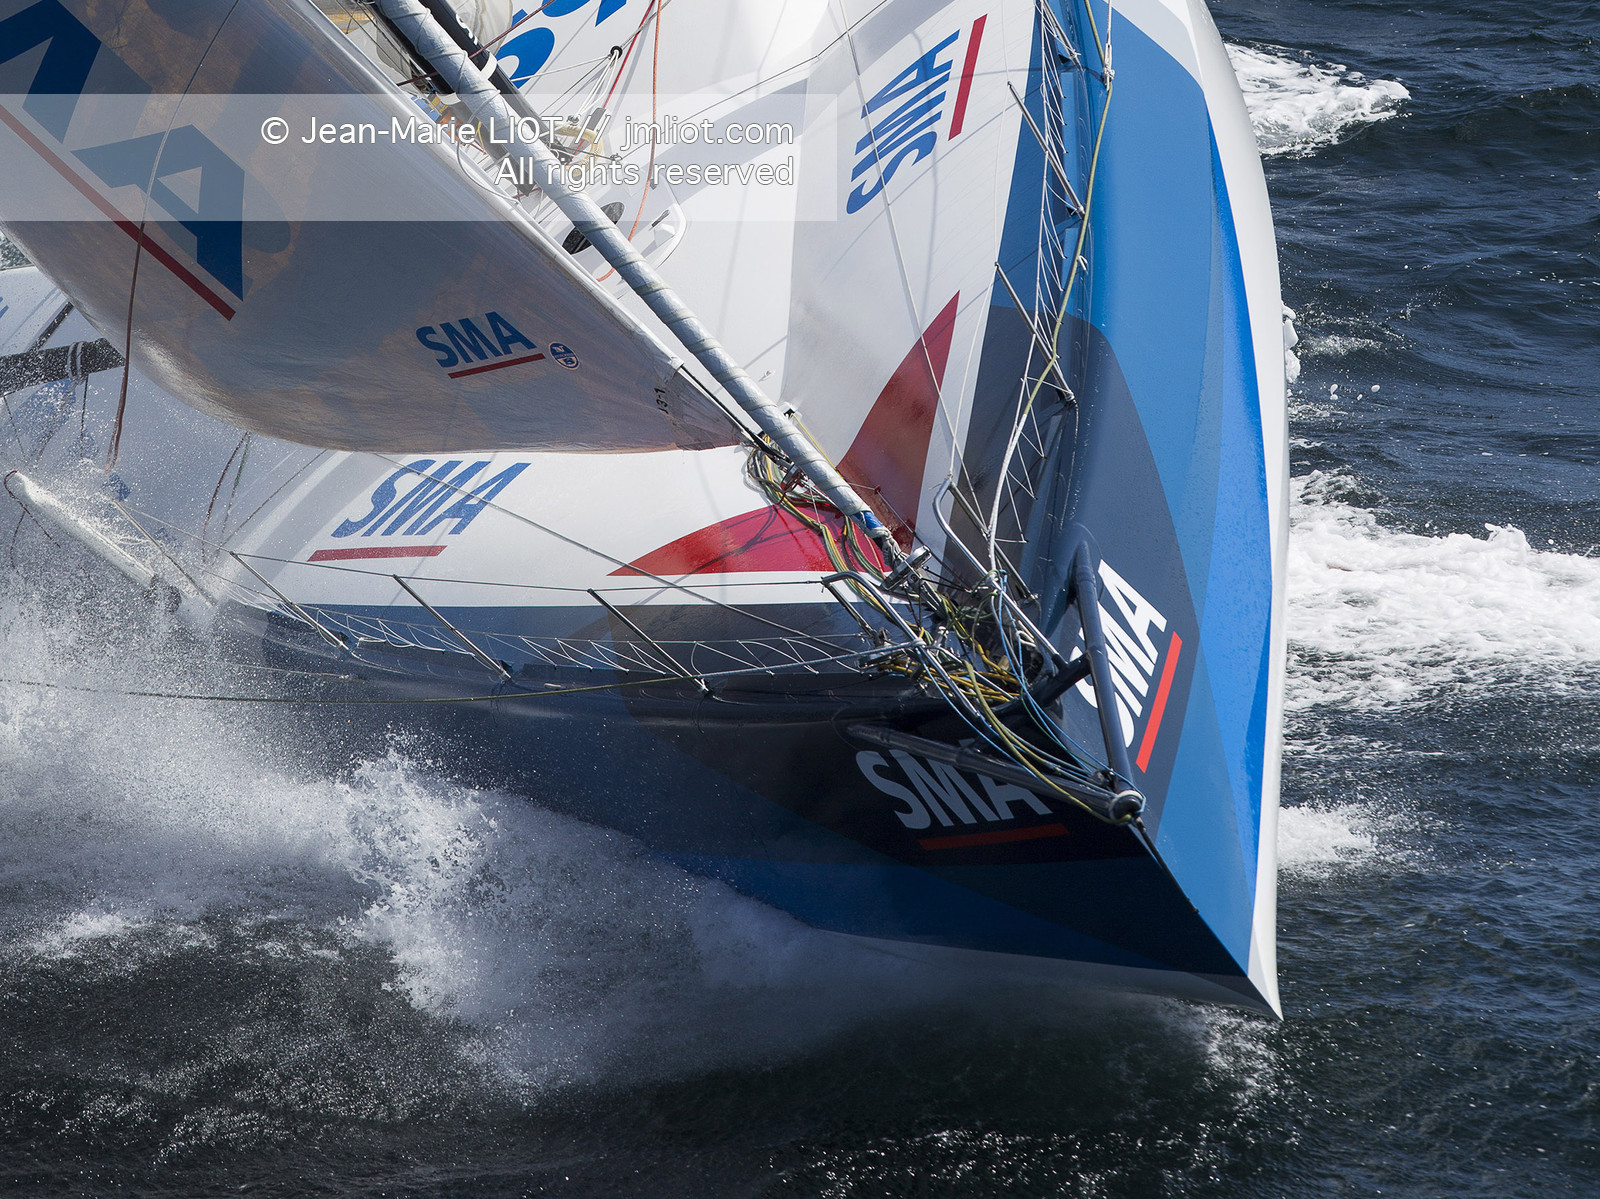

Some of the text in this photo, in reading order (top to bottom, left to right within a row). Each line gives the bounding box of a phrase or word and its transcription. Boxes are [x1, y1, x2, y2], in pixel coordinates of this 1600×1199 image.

[846, 29, 961, 216] SMA
[415, 311, 537, 368] SMA
[330, 458, 532, 538] SMA
[856, 739, 1054, 830] SMA
